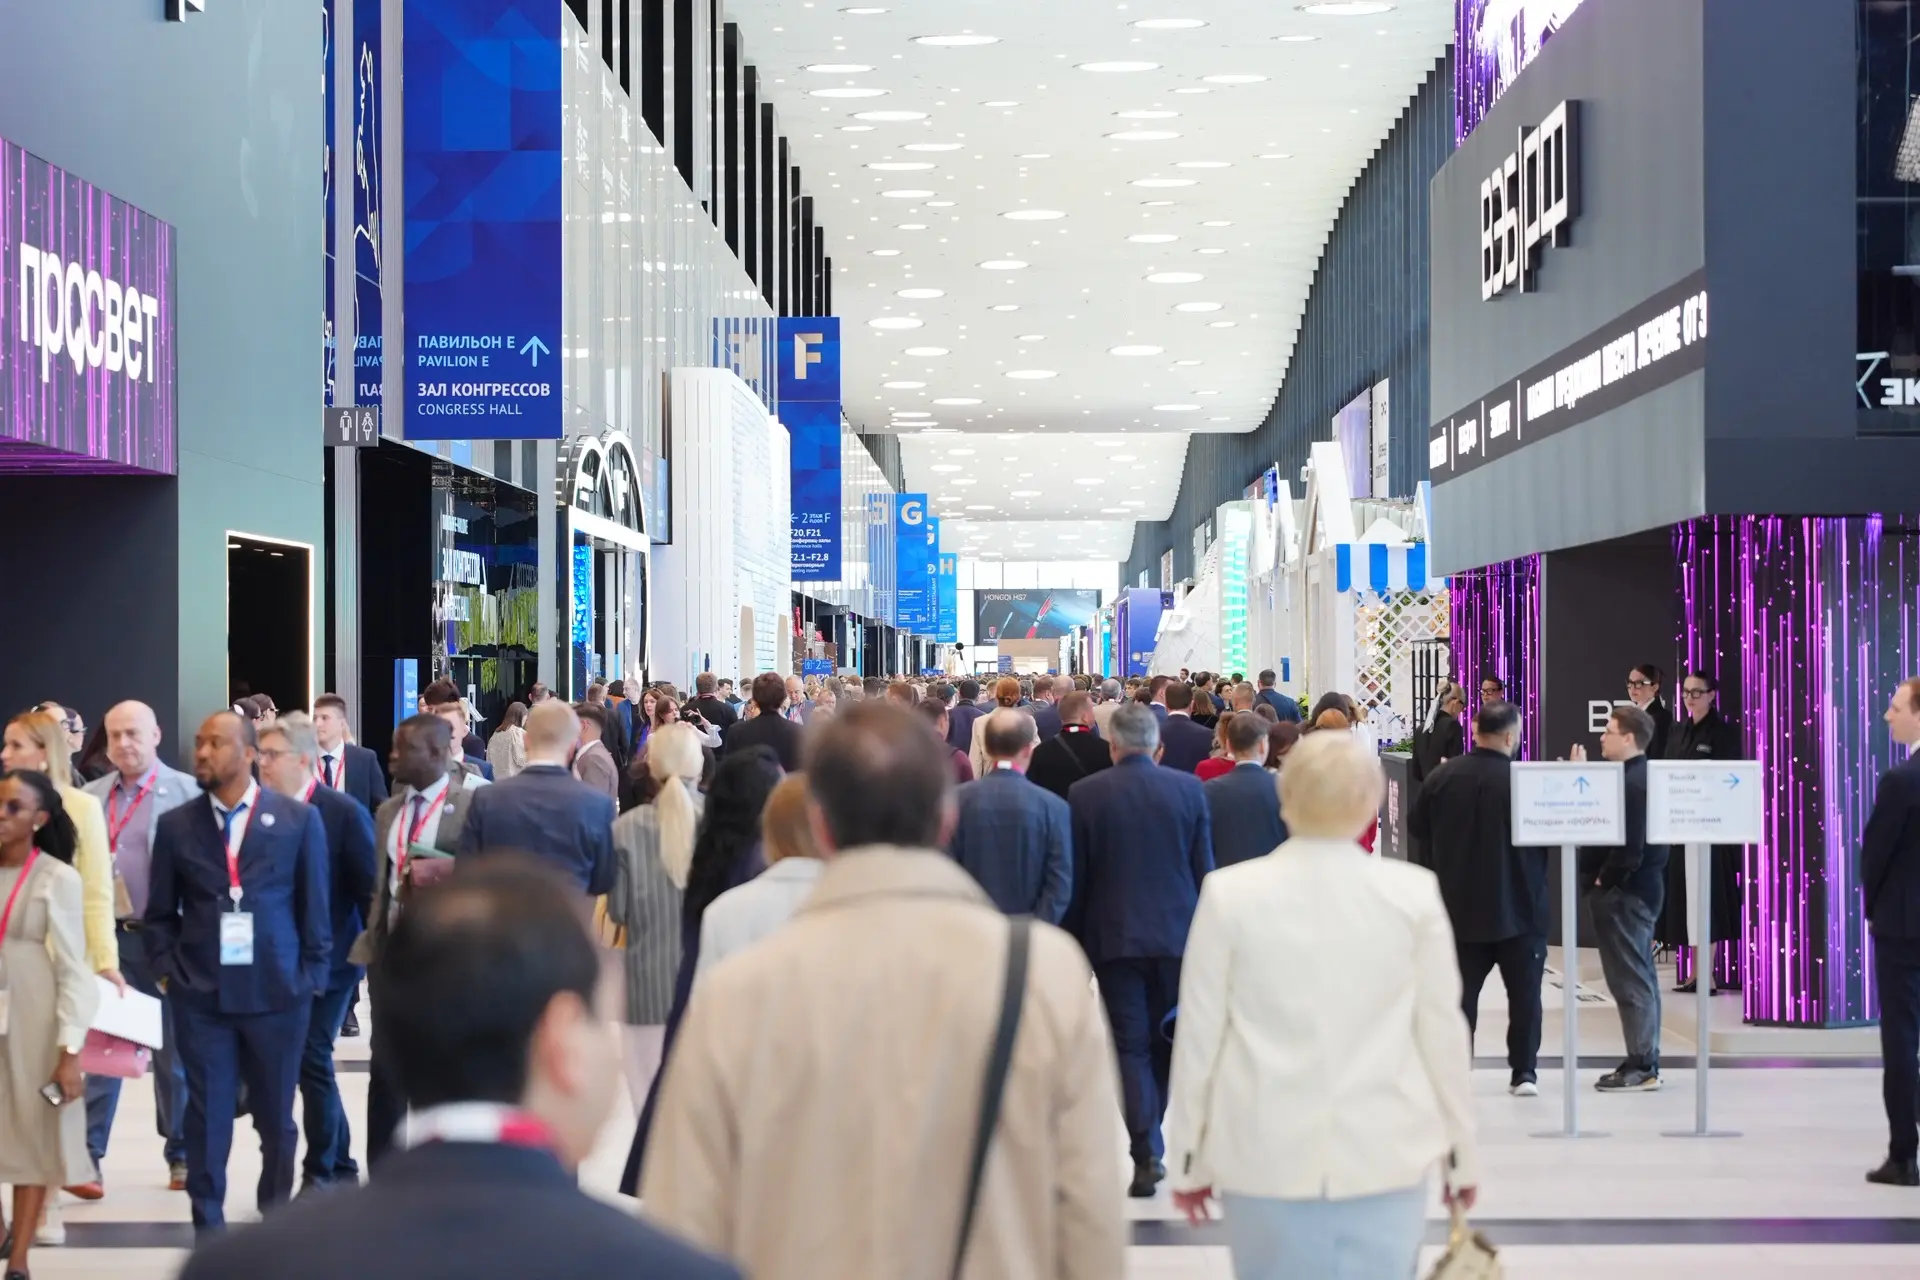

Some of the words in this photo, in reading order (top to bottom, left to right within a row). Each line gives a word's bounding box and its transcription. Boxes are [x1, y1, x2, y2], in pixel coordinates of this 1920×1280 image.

[20, 242, 158, 383] просвет
[418, 335, 502, 349] ПАВИЛЬОН
[418, 355, 478, 367] PAVILION
[482, 355, 489, 367] E
[794, 333, 823, 380] F
[417, 383, 447, 397] ЗАЛ
[451, 383, 551, 397] КОНГРЕССОВ
[417, 403, 485, 415] CONGRESS
[489, 403, 522, 415] HALL
[802, 512, 808, 524] 2
[824, 512, 831, 524] F
[901, 501, 923, 525] G
[940, 558, 953, 575] H
